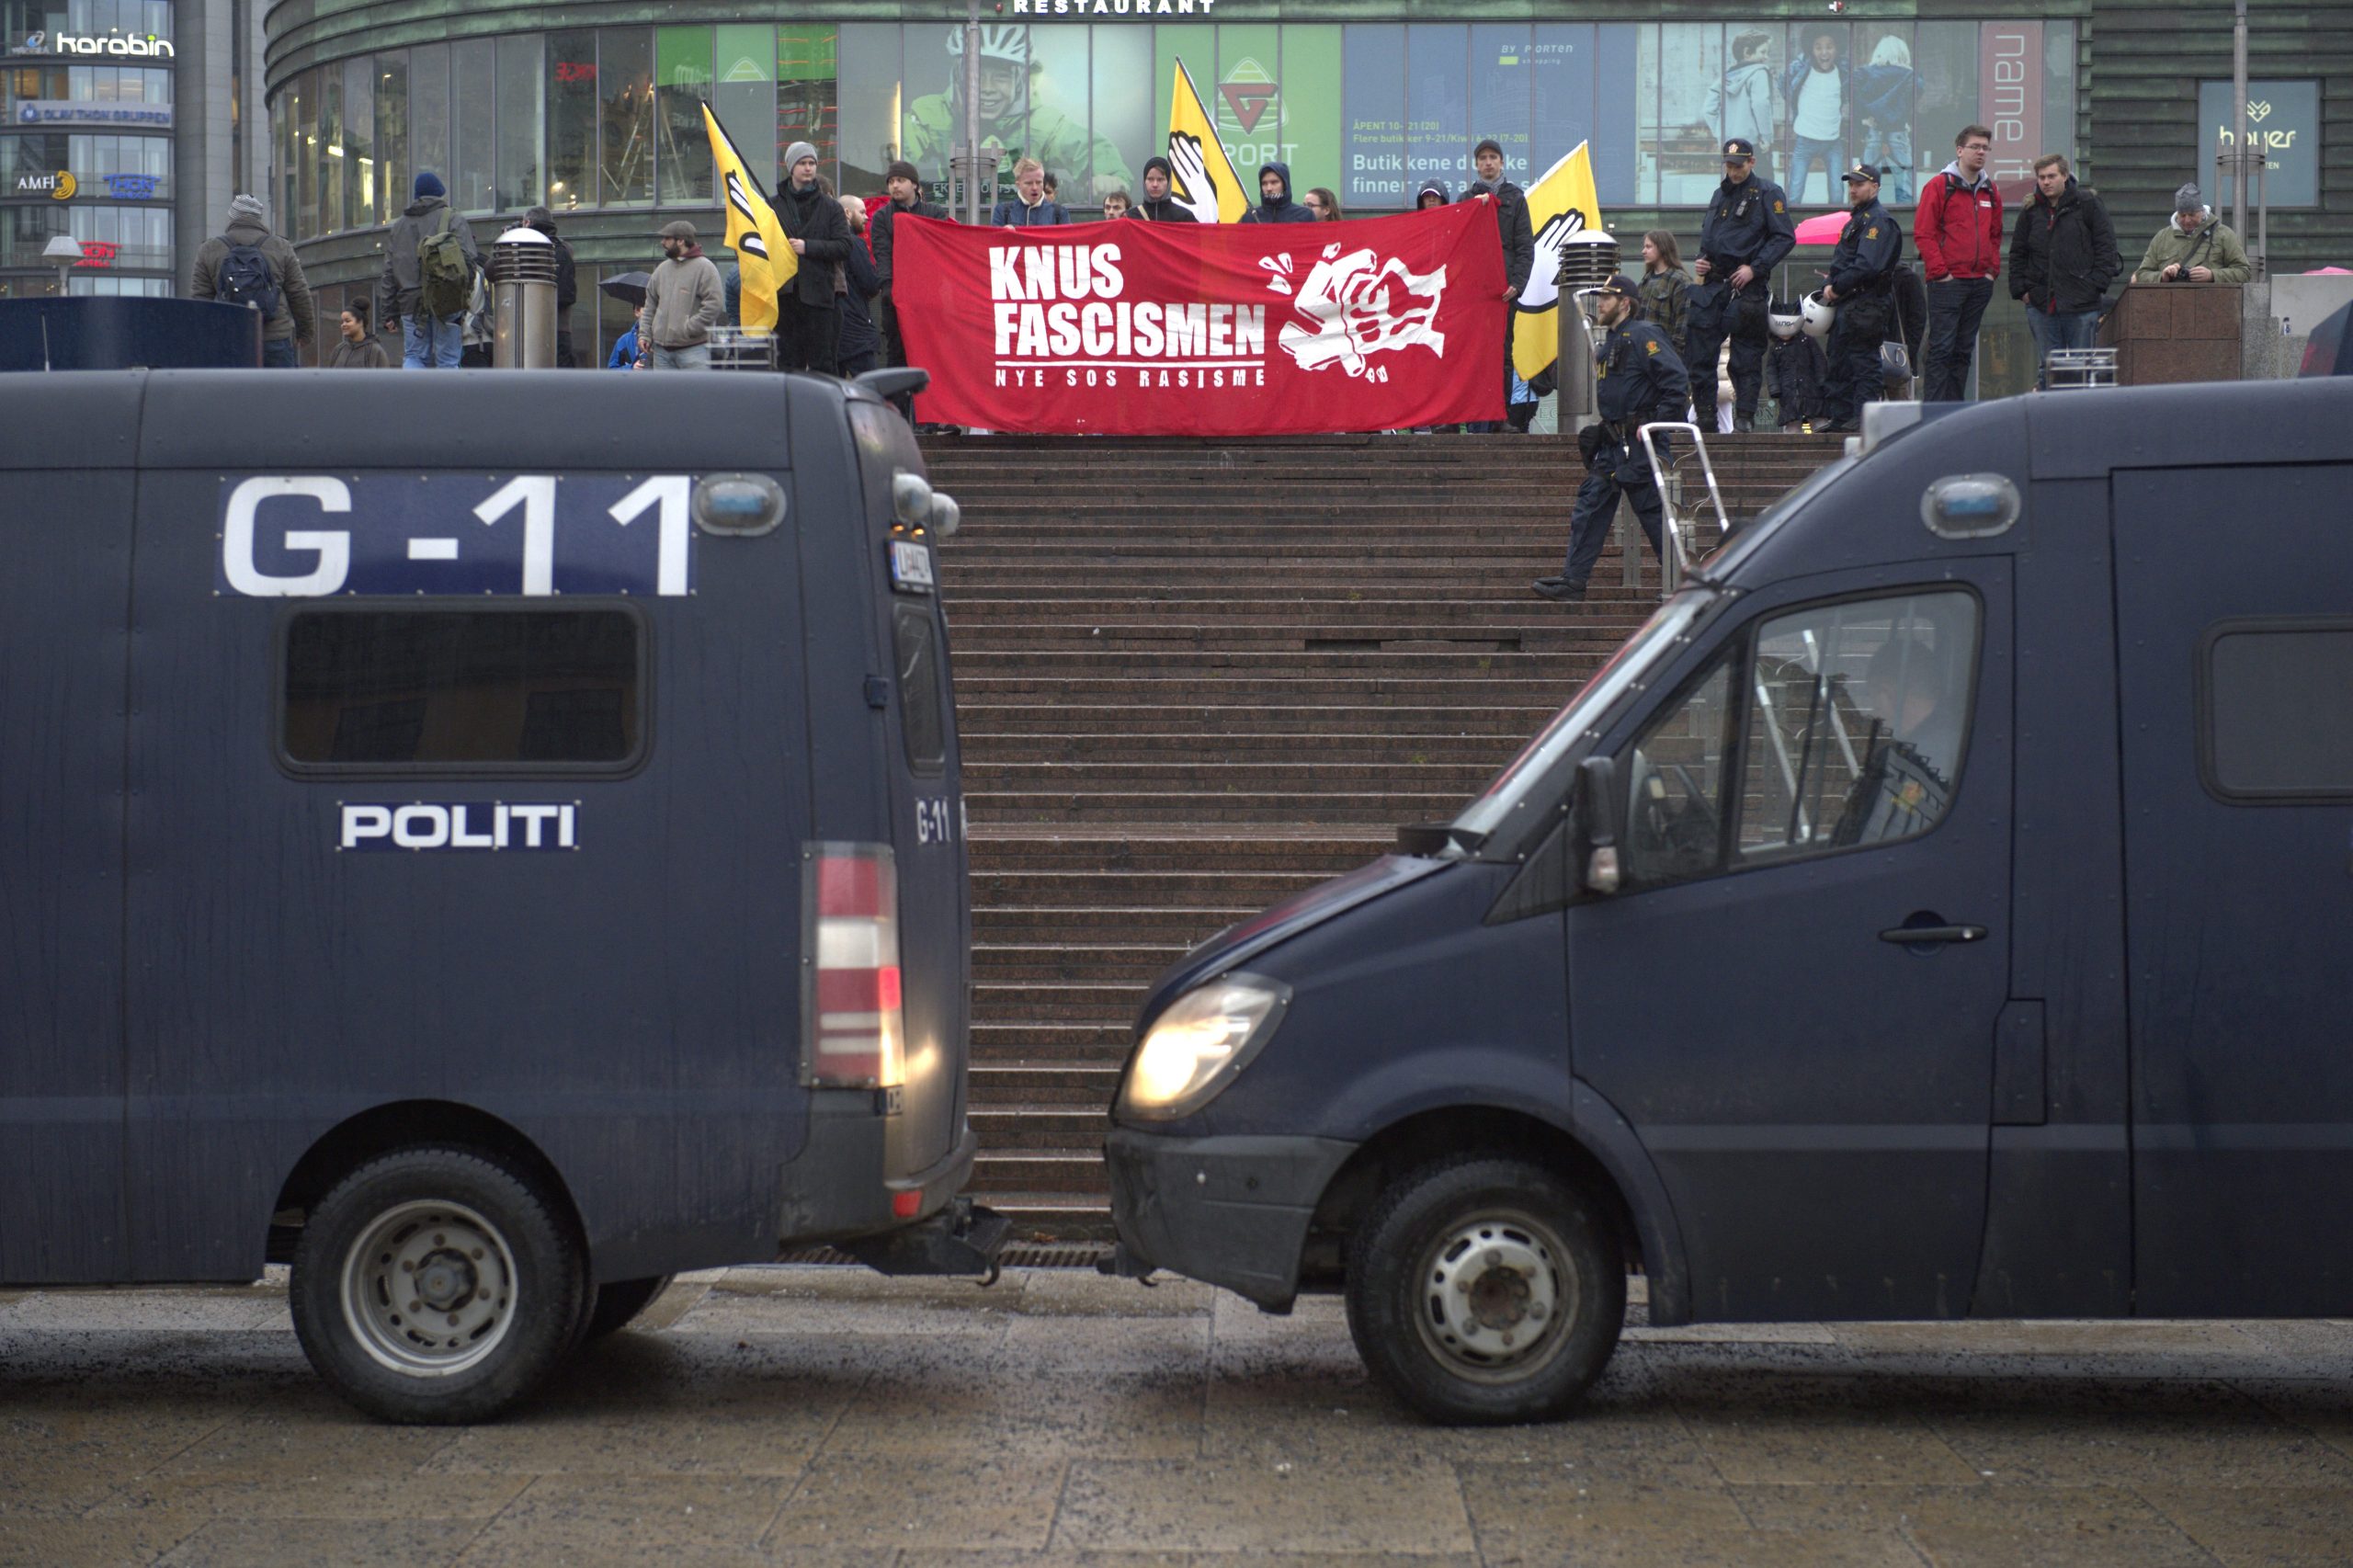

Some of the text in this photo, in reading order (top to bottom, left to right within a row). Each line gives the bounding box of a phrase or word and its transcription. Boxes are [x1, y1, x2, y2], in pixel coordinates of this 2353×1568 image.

[1013, 0, 1214, 14] RESTAURANT
[57, 31, 175, 58] karabin
[1994, 35, 2032, 181] name it
[1352, 119, 1386, 131] ÅPENT
[1353, 134, 1378, 143] Flere
[1381, 134, 1423, 143] butikker
[1353, 153, 1451, 171] Butikkene
[17, 175, 55, 190] AMFI
[102, 174, 162, 191] THON
[1352, 176, 1413, 193] finner
[988, 243, 1124, 301] KNUS
[994, 301, 1266, 358] FASCISMEN
[995, 369, 1265, 389] NYE SOS RASISME
[222, 475, 691, 597] G-11
[341, 804, 574, 848] POLITI
[916, 799, 952, 843] G-11
